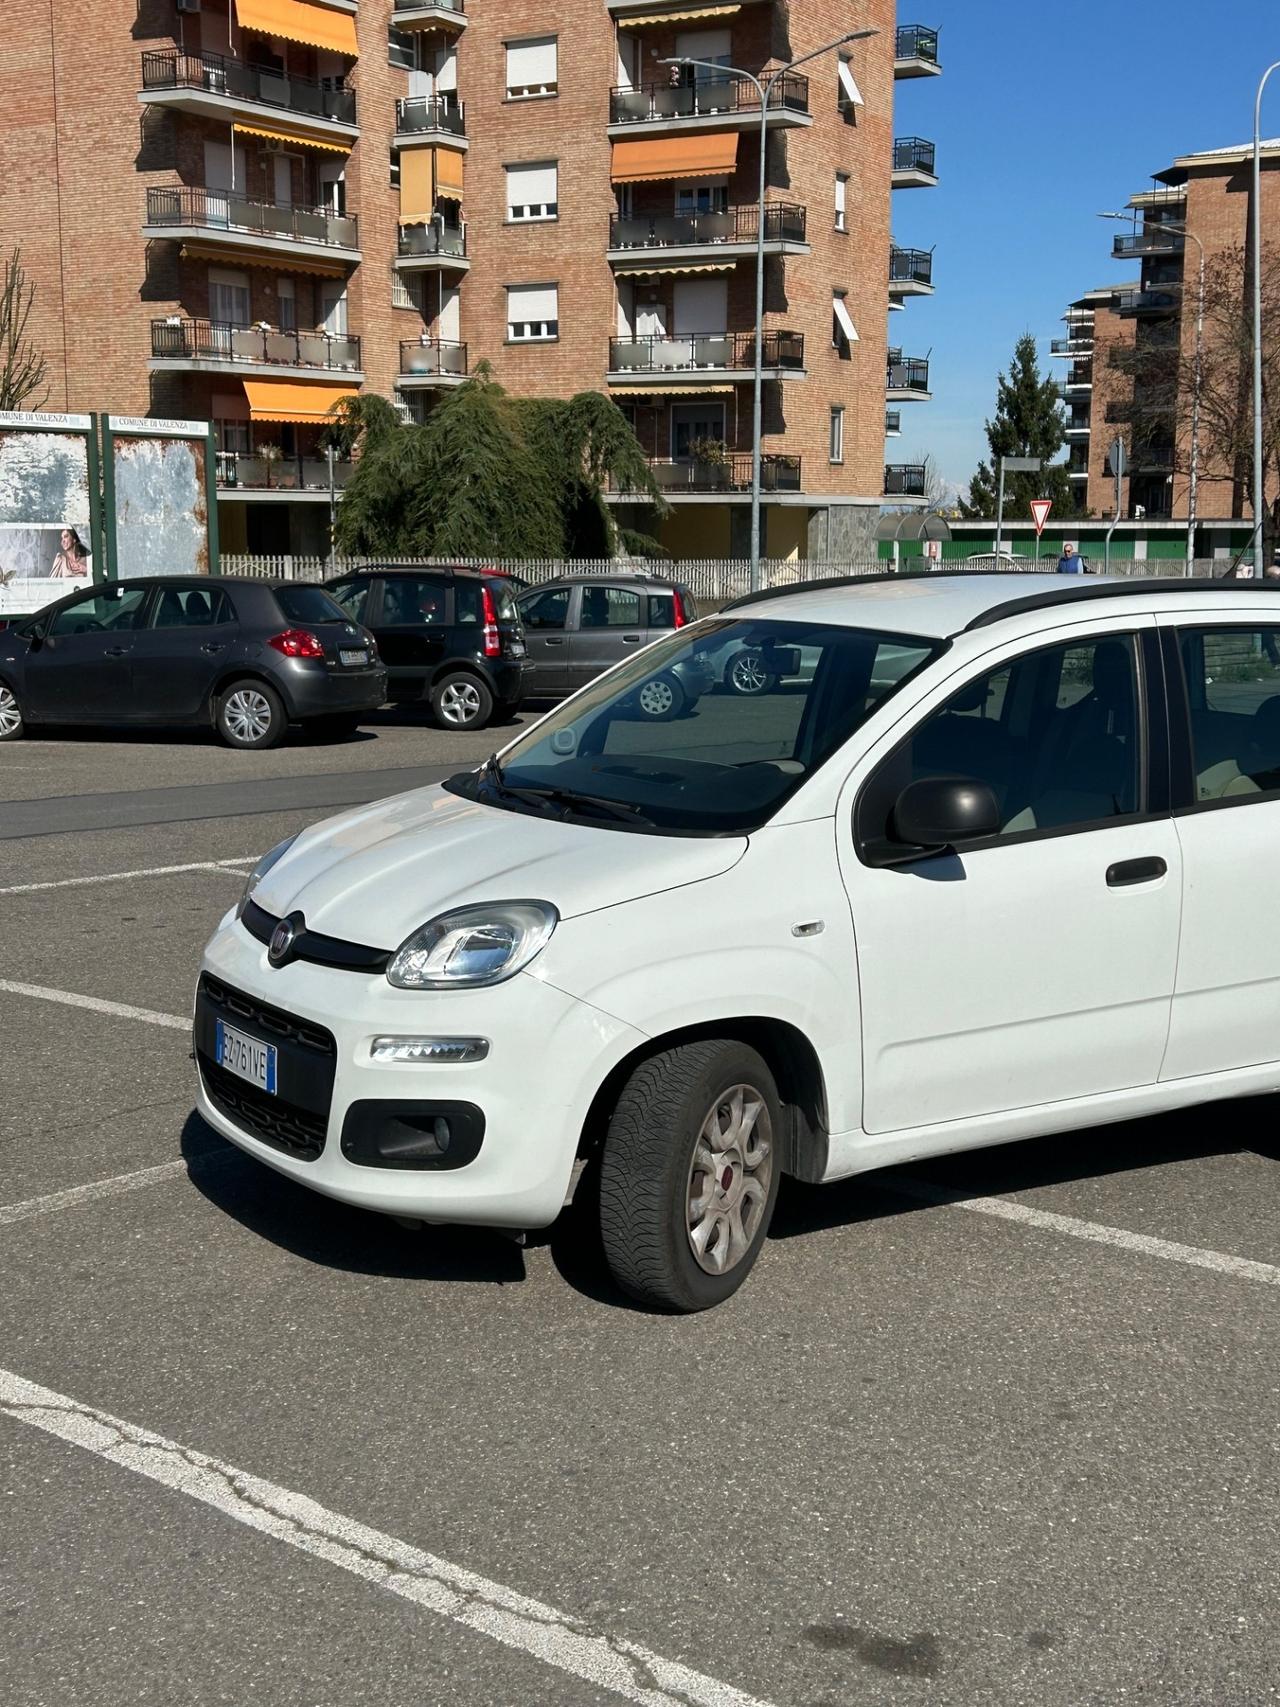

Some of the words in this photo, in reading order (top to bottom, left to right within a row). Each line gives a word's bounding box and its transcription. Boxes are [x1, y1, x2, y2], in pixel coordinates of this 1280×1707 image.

[0, 412, 24, 421] MUNE
[26, 413, 34, 421] DI
[35, 413, 67, 423] VALENZA
[118, 417, 149, 427] COMUNE
[150, 419, 158, 428] DI
[158, 419, 188, 430] VALENZA
